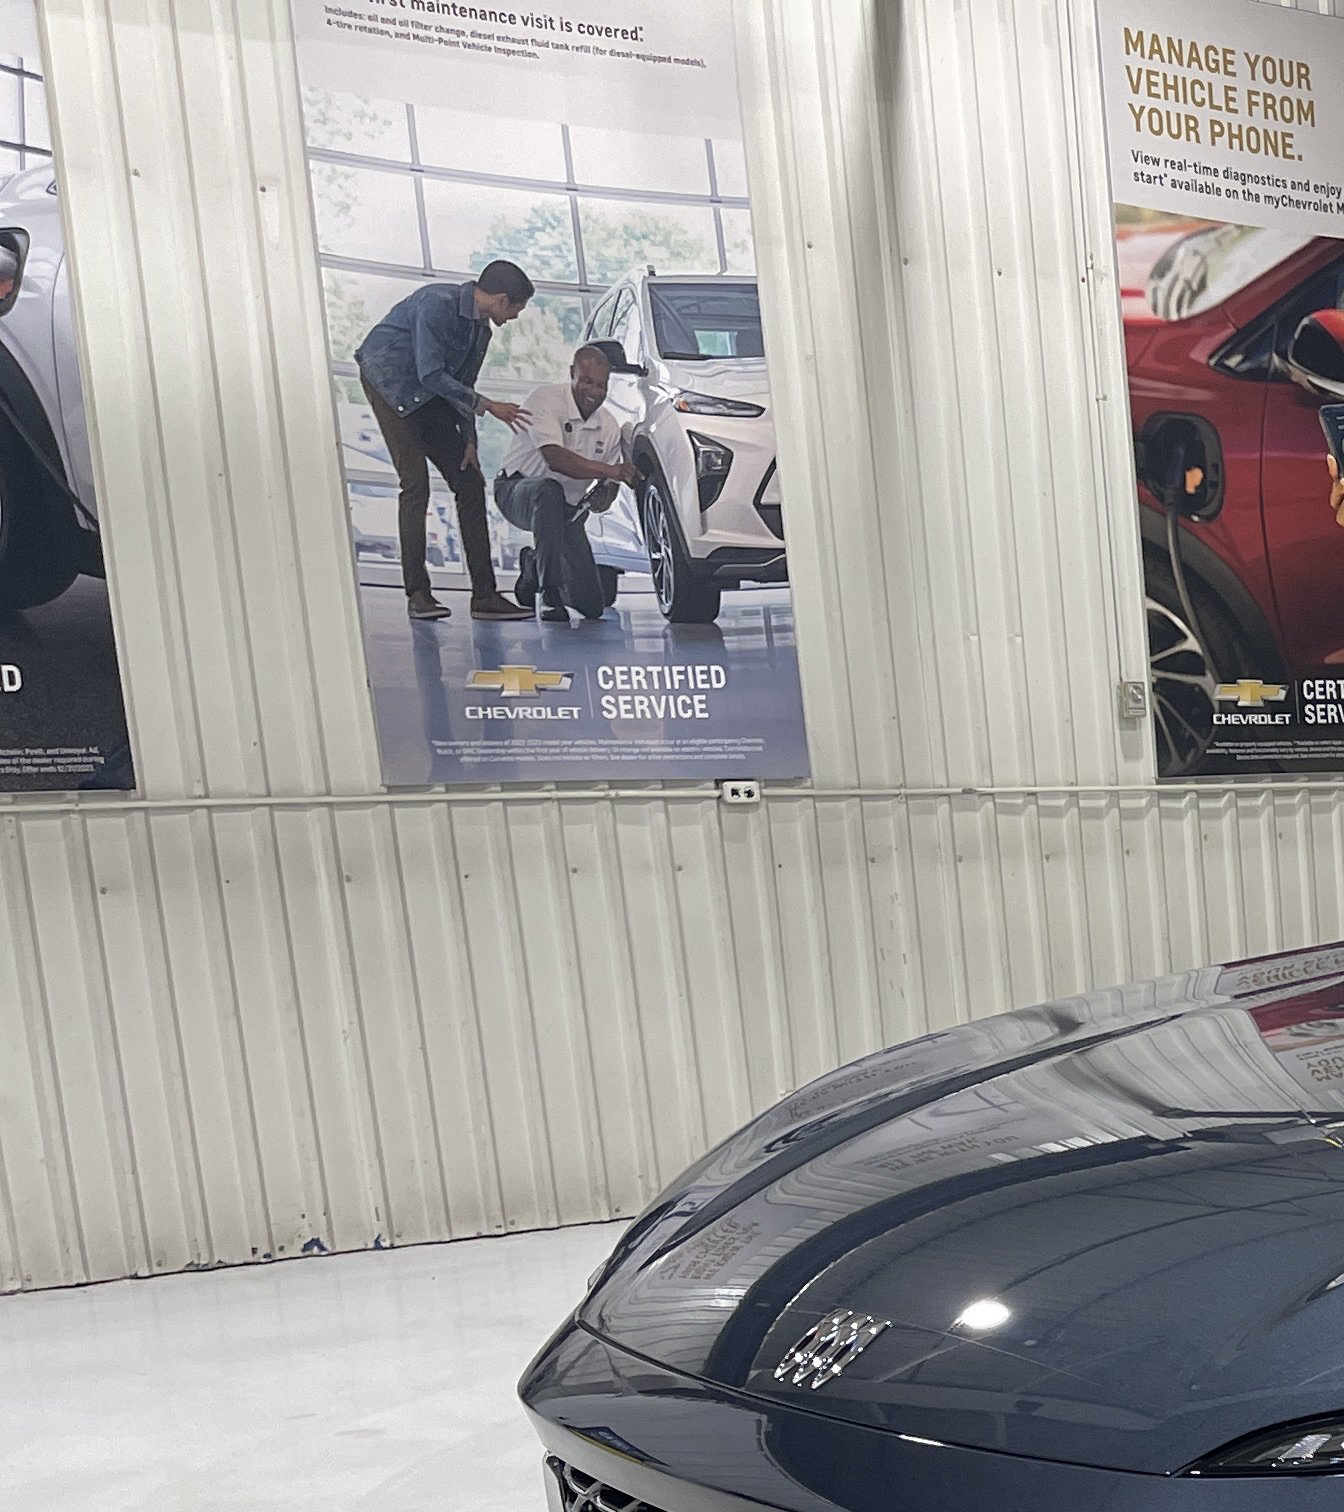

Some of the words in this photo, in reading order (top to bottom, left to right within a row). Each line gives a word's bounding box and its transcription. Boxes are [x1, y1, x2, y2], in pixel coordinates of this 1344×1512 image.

[410, 0, 517, 25] maintenance
[520, 12, 556, 31] visit
[559, 16, 573, 33] is
[1123, 27, 1237, 78] MANAGE
[1244, 51, 1312, 91] YOUR
[1125, 65, 1239, 115] VEHICLE
[1247, 89, 1316, 128] FROM
[1127, 103, 1201, 145] YOUR
[1209, 119, 1304, 162] PHONE.
[1131, 149, 1160, 167] View
[1164, 158, 1220, 178] real-time
[1222, 166, 1288, 189] diagnostics
[1290, 179, 1310, 193] and
[1313, 182, 1342, 199] enjoy
[1170, 178, 1222, 197] available
[1225, 188, 1240, 200] on
[1242, 188, 1261, 203] the
[1263, 194, 1334, 214] myChevrolet
[596, 664, 727, 691] CERTIFIED
[464, 705, 582, 720] CHEVROLET
[601, 694, 710, 720] SERVICE
[1212, 713, 1292, 725] CHEVROLET
